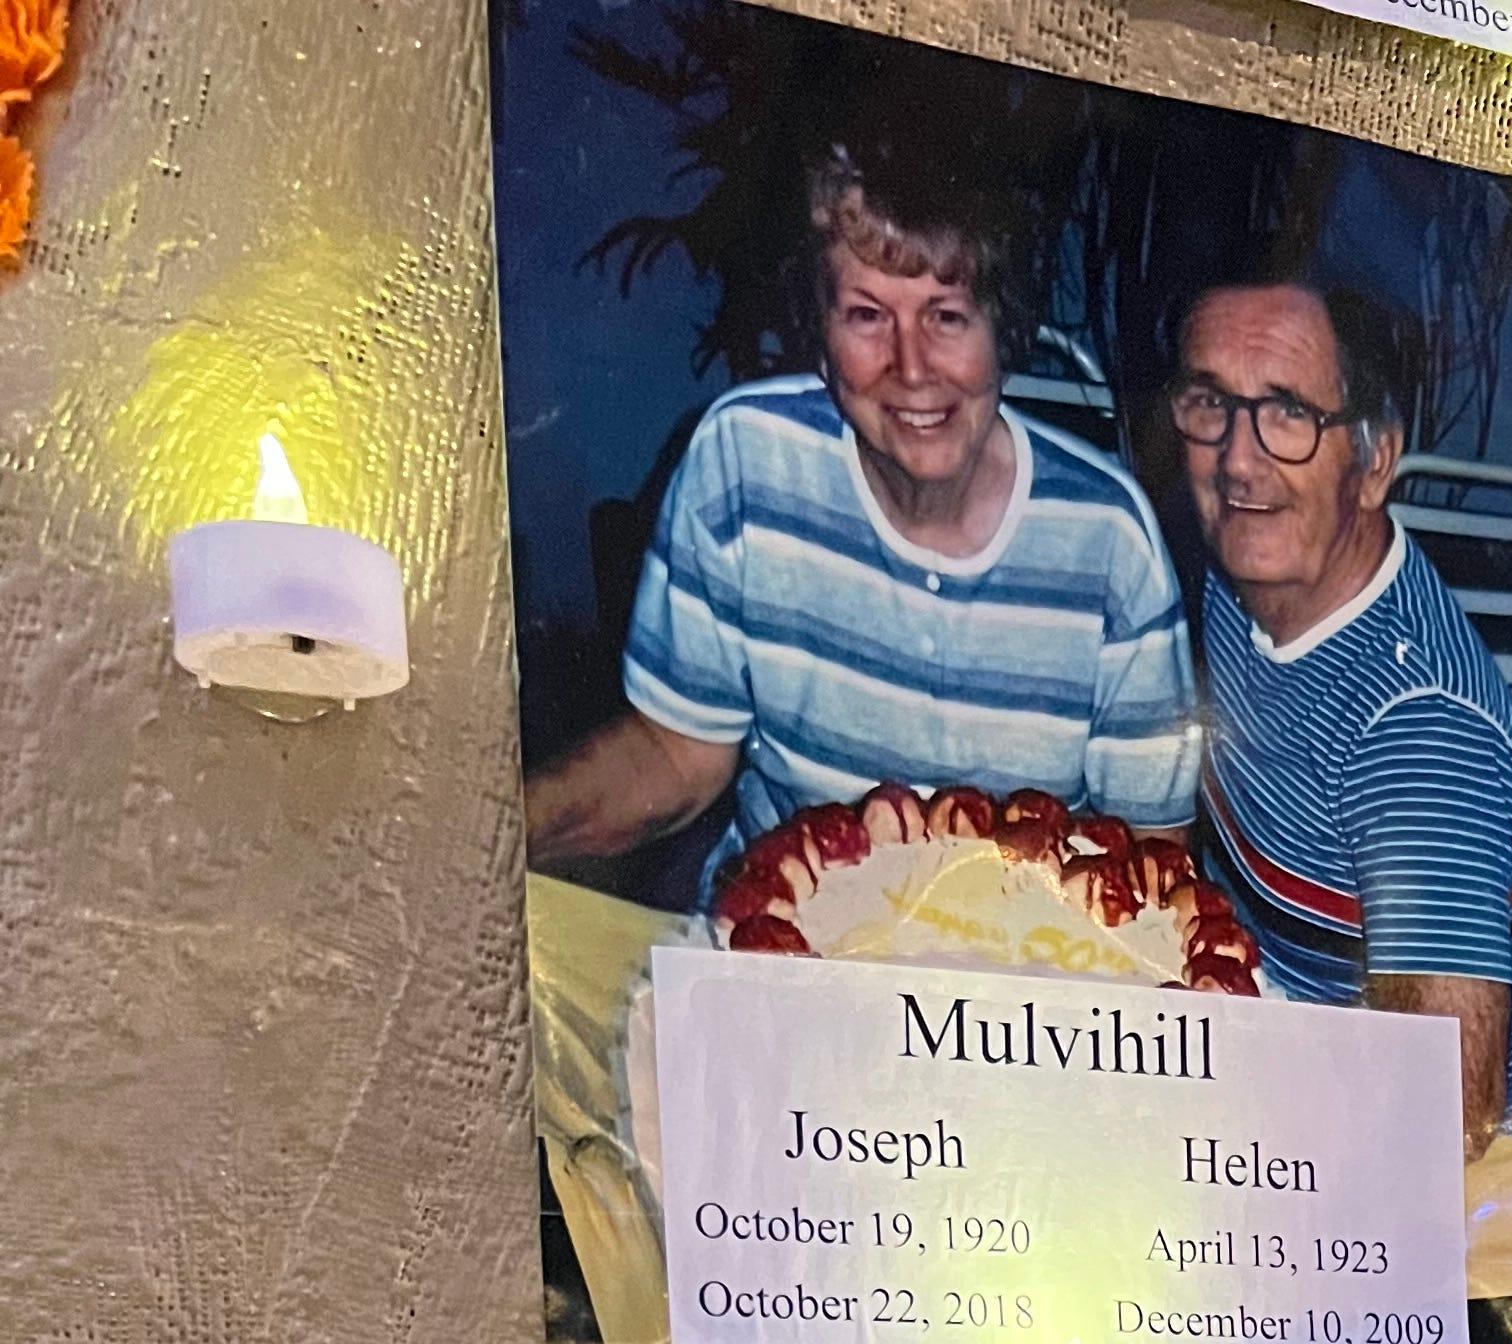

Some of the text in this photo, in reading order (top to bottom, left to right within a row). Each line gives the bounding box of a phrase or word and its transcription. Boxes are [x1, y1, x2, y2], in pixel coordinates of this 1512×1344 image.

[897, 992, 1218, 1082] Mulvihill
[784, 1109, 968, 1182] Joseph
[1181, 1135, 1320, 1195] Helen
[694, 1201, 1031, 1257] October 19, 1920
[1146, 1227, 1390, 1277] April 13, 1923
[697, 1279, 1035, 1333] October 22, 2018
[1115, 1299, 1293, 1344] December
